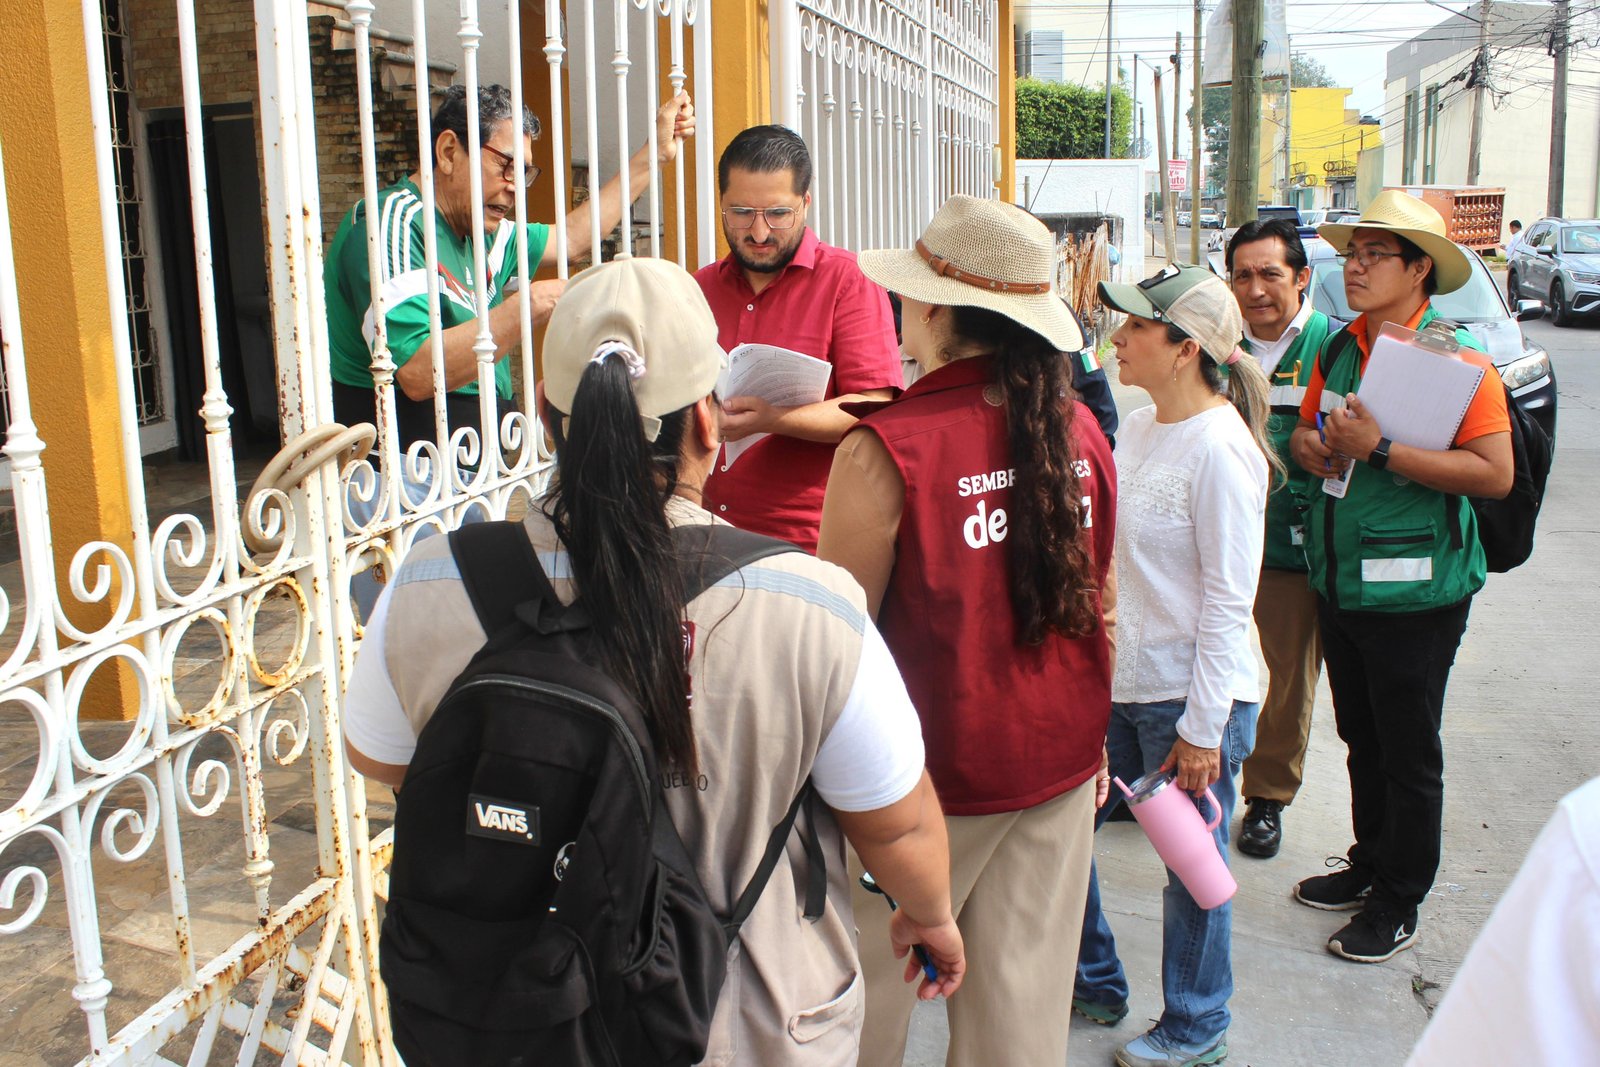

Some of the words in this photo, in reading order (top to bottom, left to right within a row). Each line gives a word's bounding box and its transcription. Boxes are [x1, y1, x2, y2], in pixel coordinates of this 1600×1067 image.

[1171, 176, 1185, 184] uto
[963, 500, 1008, 549] de
[475, 803, 528, 834] VANS
